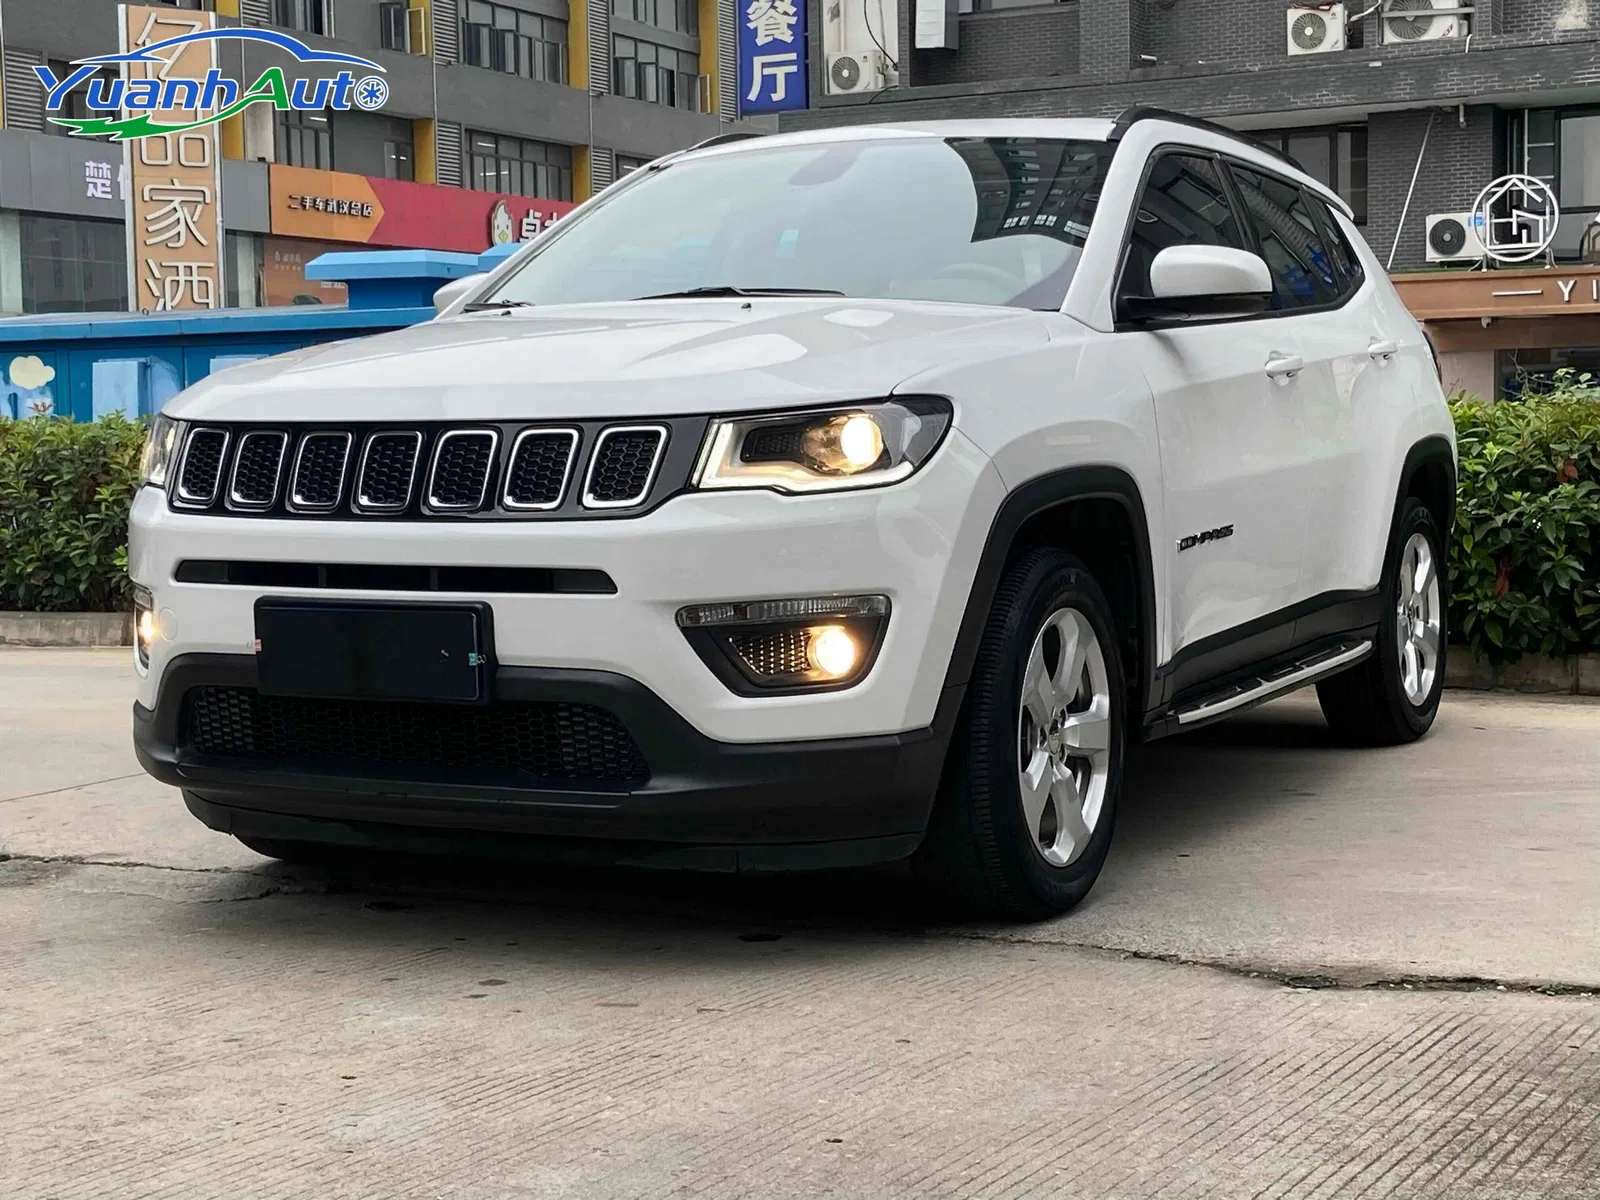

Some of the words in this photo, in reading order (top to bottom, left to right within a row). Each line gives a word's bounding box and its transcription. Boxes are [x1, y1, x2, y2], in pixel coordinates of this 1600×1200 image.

[746, 0, 798, 102] 餐厅
[84, 160, 126, 201] 楚
[519, 208, 561, 244] 卓
